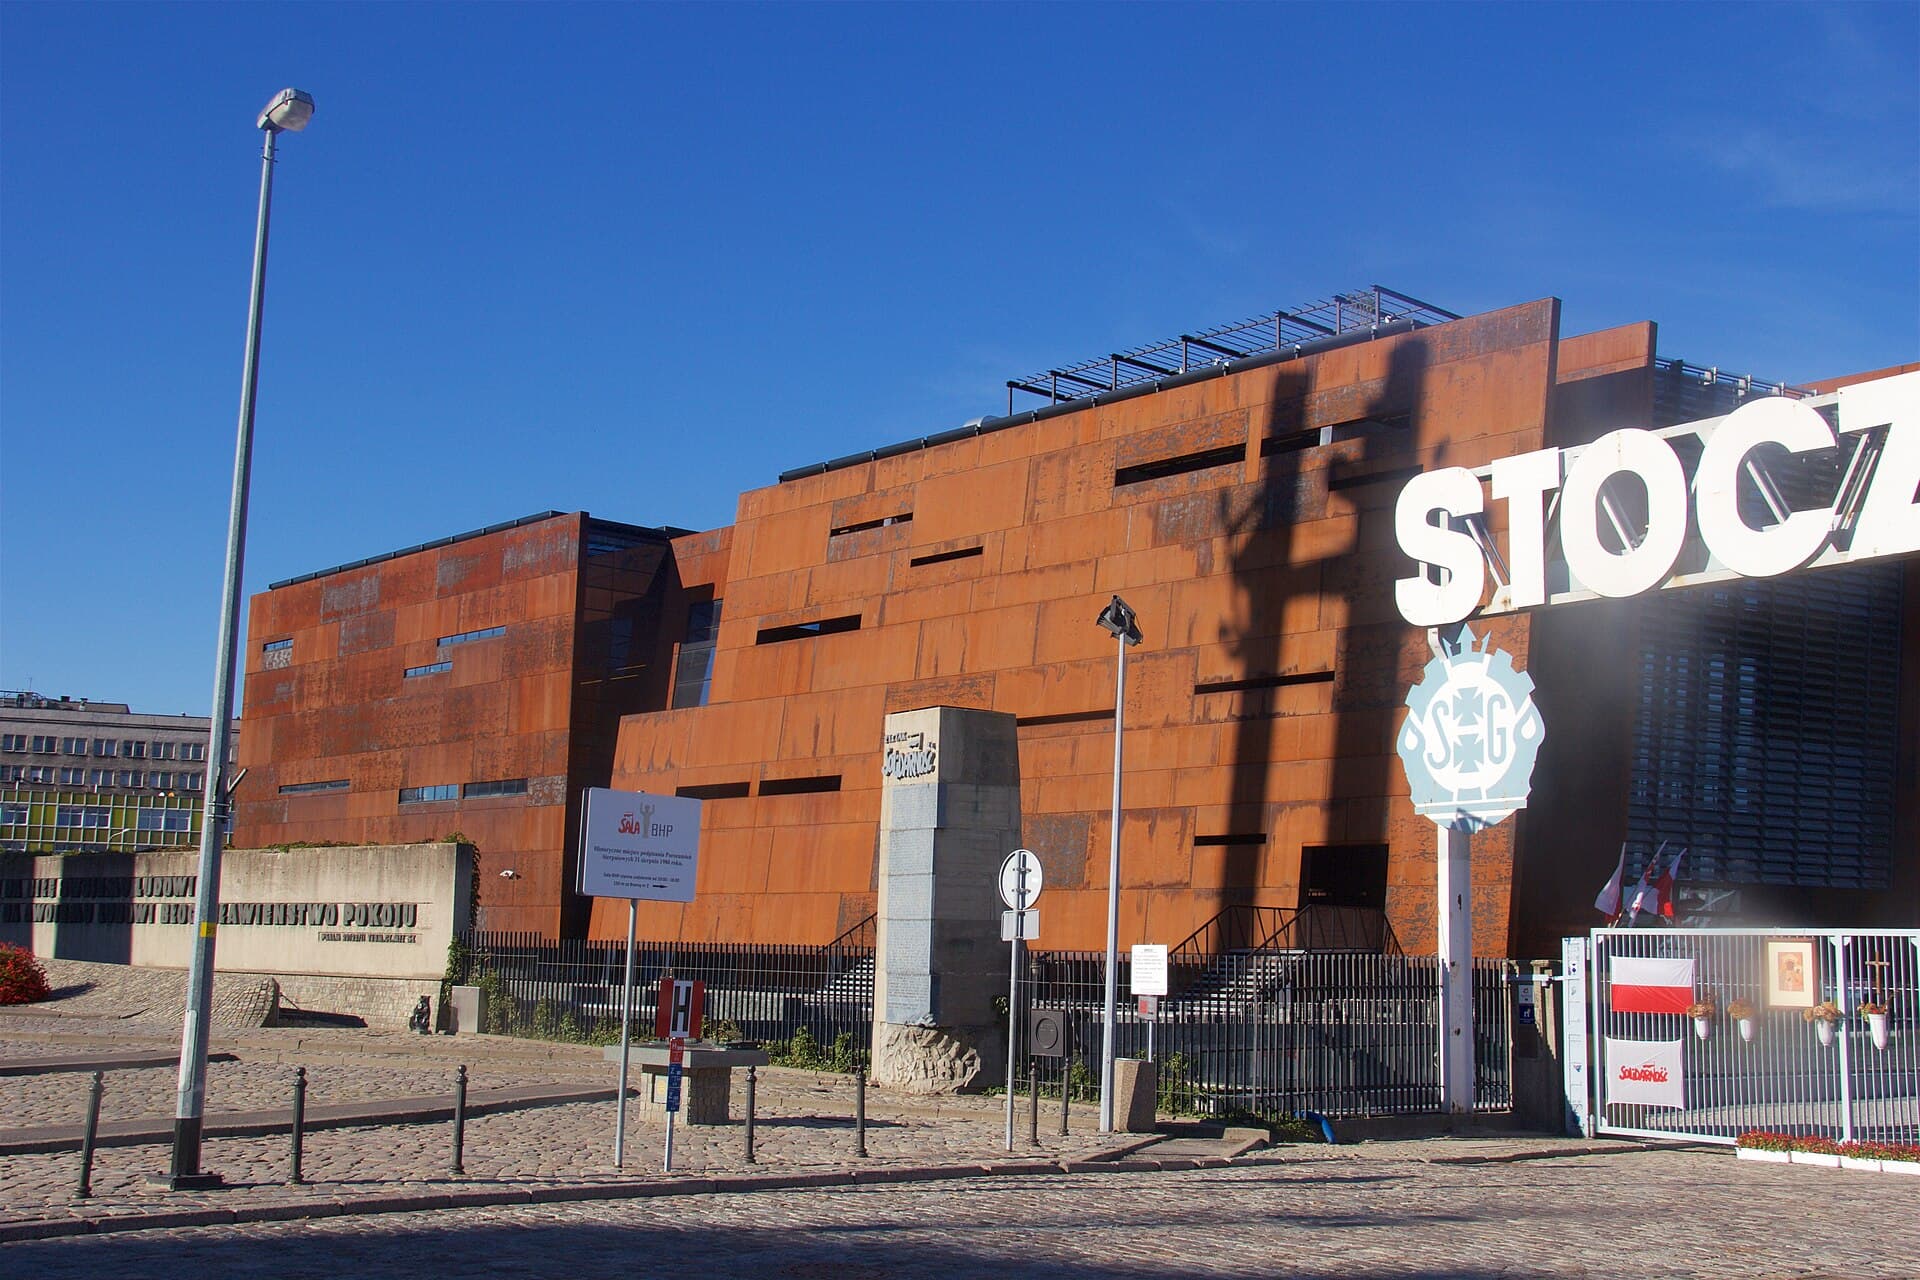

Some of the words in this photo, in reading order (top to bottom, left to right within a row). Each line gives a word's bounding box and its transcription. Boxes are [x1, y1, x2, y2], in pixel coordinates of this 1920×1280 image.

[651, 823, 674, 838] BHP
[136, 876, 197, 897] LUDOWI
[343, 903, 417, 927] POKOJU
[671, 986, 692, 1032] H
